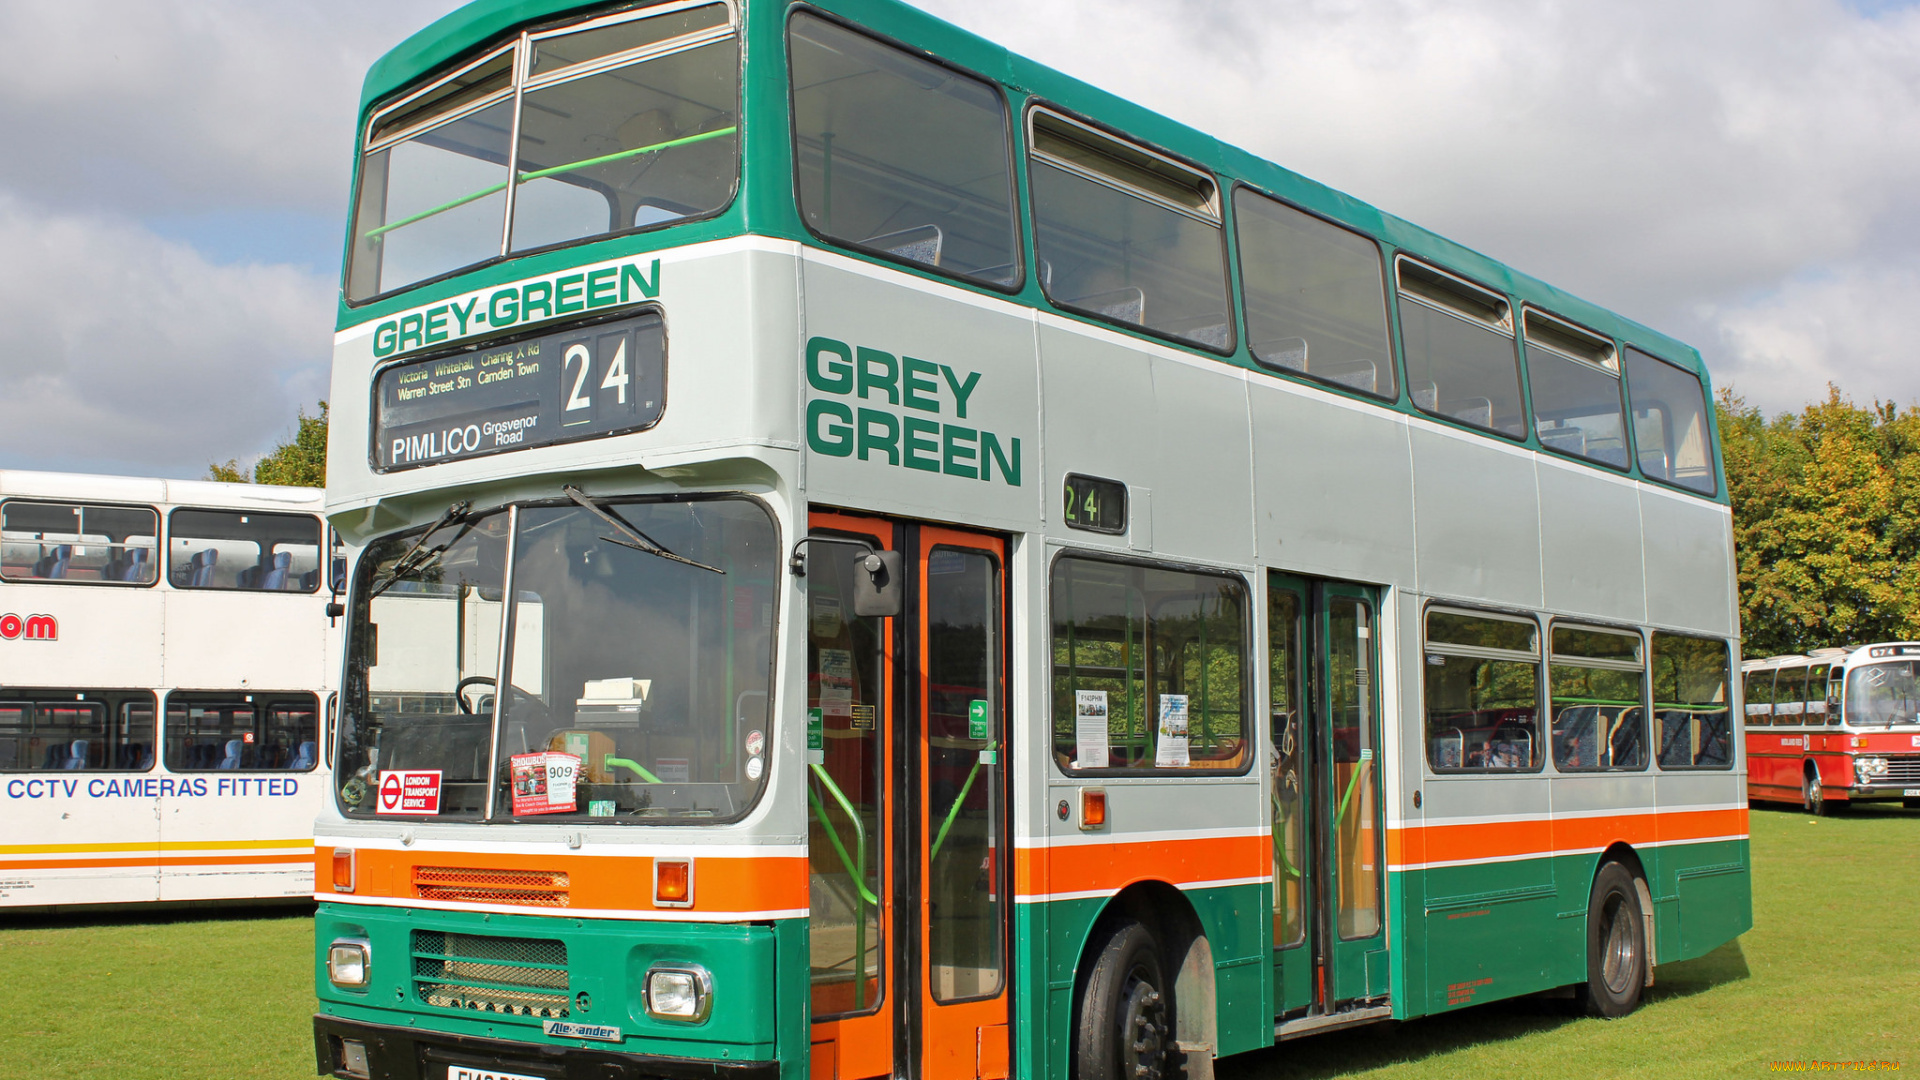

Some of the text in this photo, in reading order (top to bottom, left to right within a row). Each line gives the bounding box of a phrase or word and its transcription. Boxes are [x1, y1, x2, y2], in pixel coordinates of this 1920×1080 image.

[373, 258, 660, 358] GREY-GREEN
[398, 343, 540, 384] Victoria Whitehall Charing X Rd
[564, 337, 629, 412] 24
[806, 336, 982, 419] GREY
[397, 362, 539, 401] Warren Street Stn Camden Town
[482, 415, 538, 436] Grosvenor
[495, 429, 524, 446] Road
[391, 424, 481, 464] PIMLICO
[806, 398, 1021, 487] GREEN
[1065, 485, 1097, 522] 24
[405, 776, 431, 786] LONDON
[549, 766, 573, 779] 909
[7, 778, 298, 798] CCTV CAMERAS FITTED
[405, 787, 437, 797] TRANSPORT
[403, 799, 426, 808] SERVICE
[549, 1022, 615, 1038] Alexander
